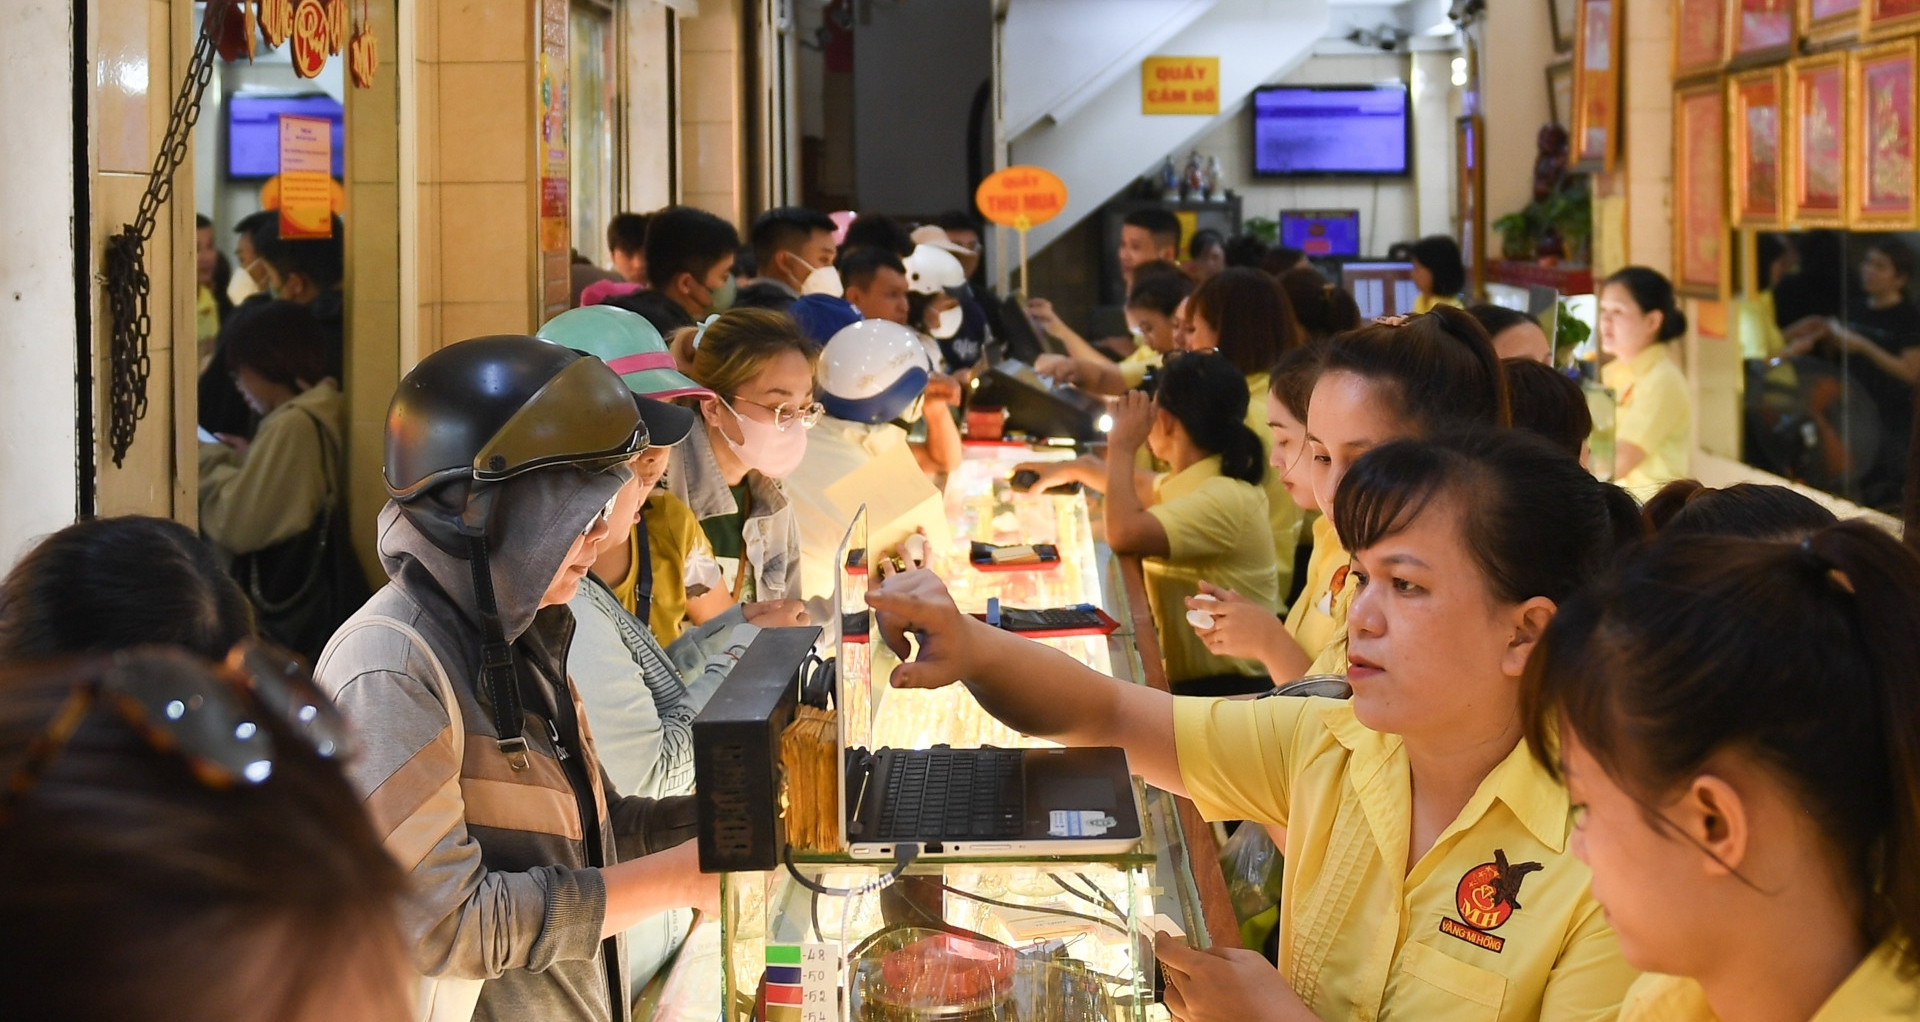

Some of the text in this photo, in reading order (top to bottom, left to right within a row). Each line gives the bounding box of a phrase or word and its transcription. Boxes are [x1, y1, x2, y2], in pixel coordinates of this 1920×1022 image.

[1023, 192, 1059, 211] MUA
[1460, 898, 1501, 928] MH
[1442, 920, 1466, 938] VÀNG
[1467, 931, 1476, 942] MI
